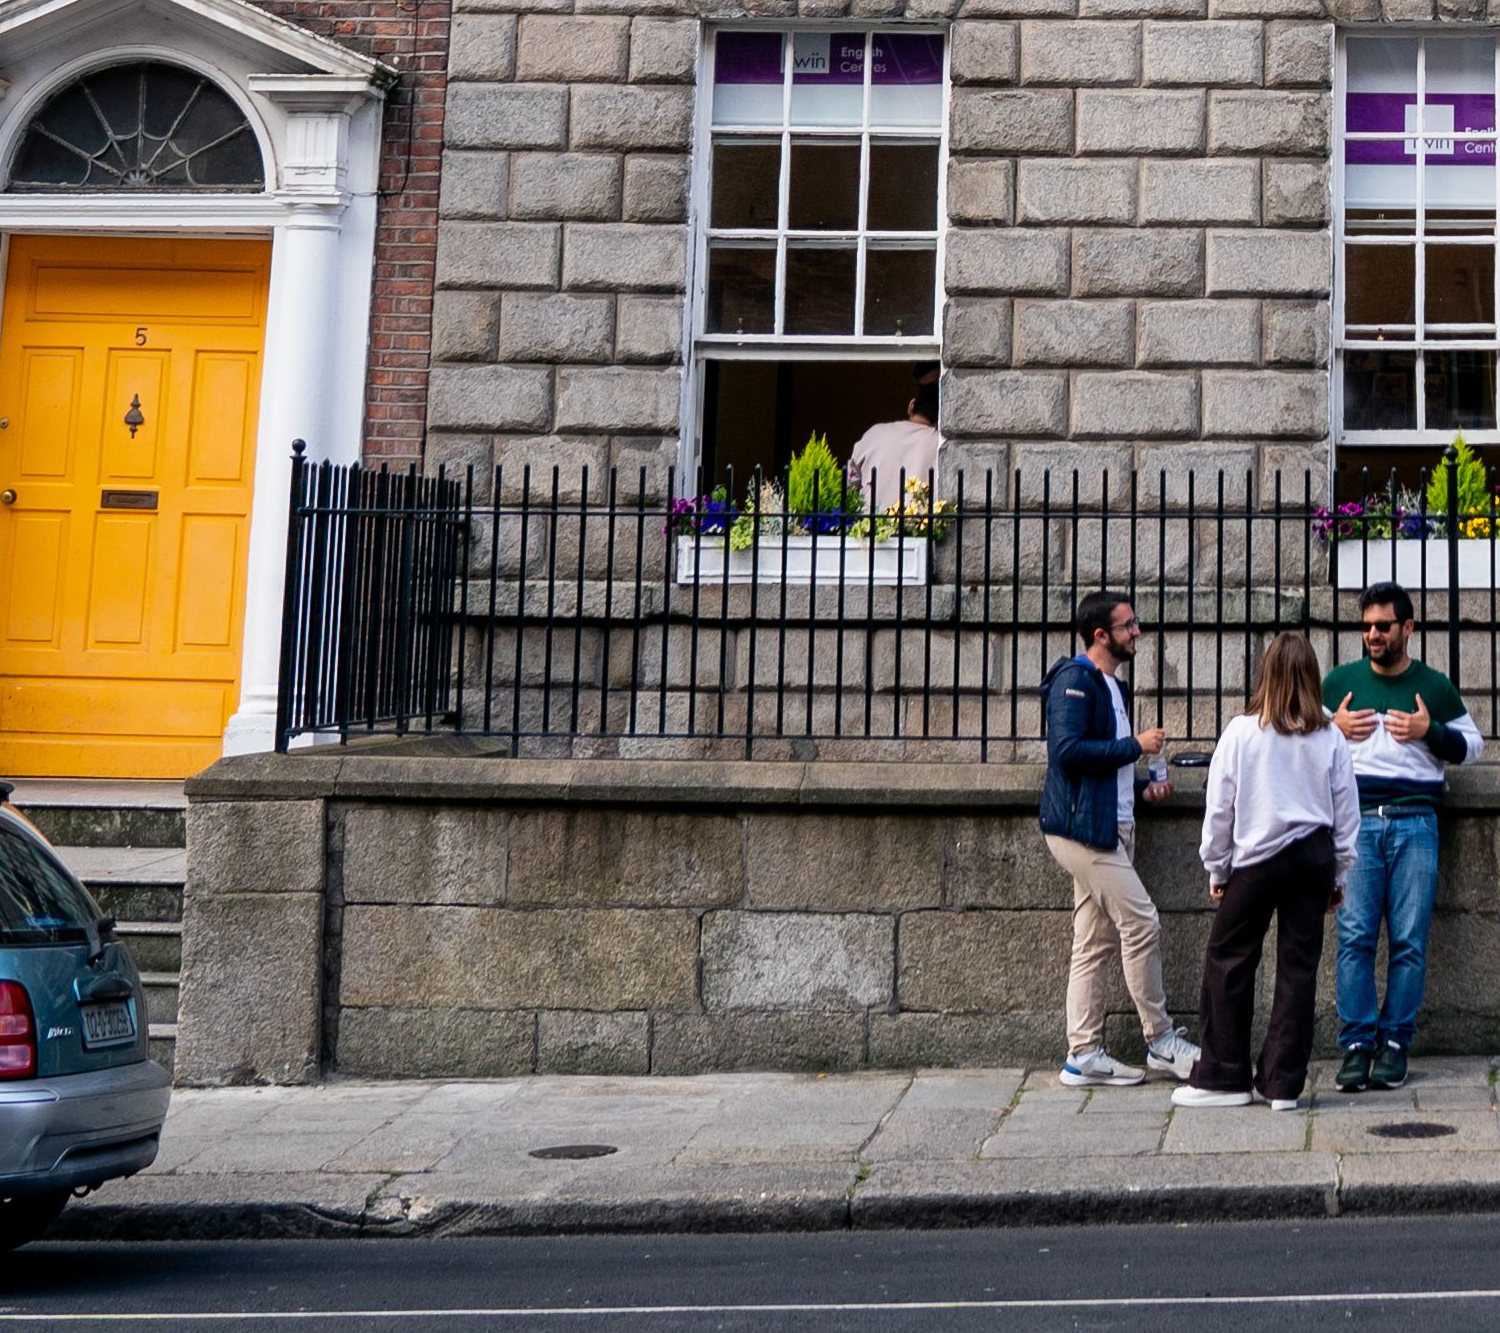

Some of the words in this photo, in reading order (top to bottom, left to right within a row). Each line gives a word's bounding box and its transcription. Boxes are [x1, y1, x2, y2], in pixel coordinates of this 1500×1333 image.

[841, 46, 883, 60] Engsh
[840, 61, 887, 73] Cenes
[135, 327, 148, 347] 5
